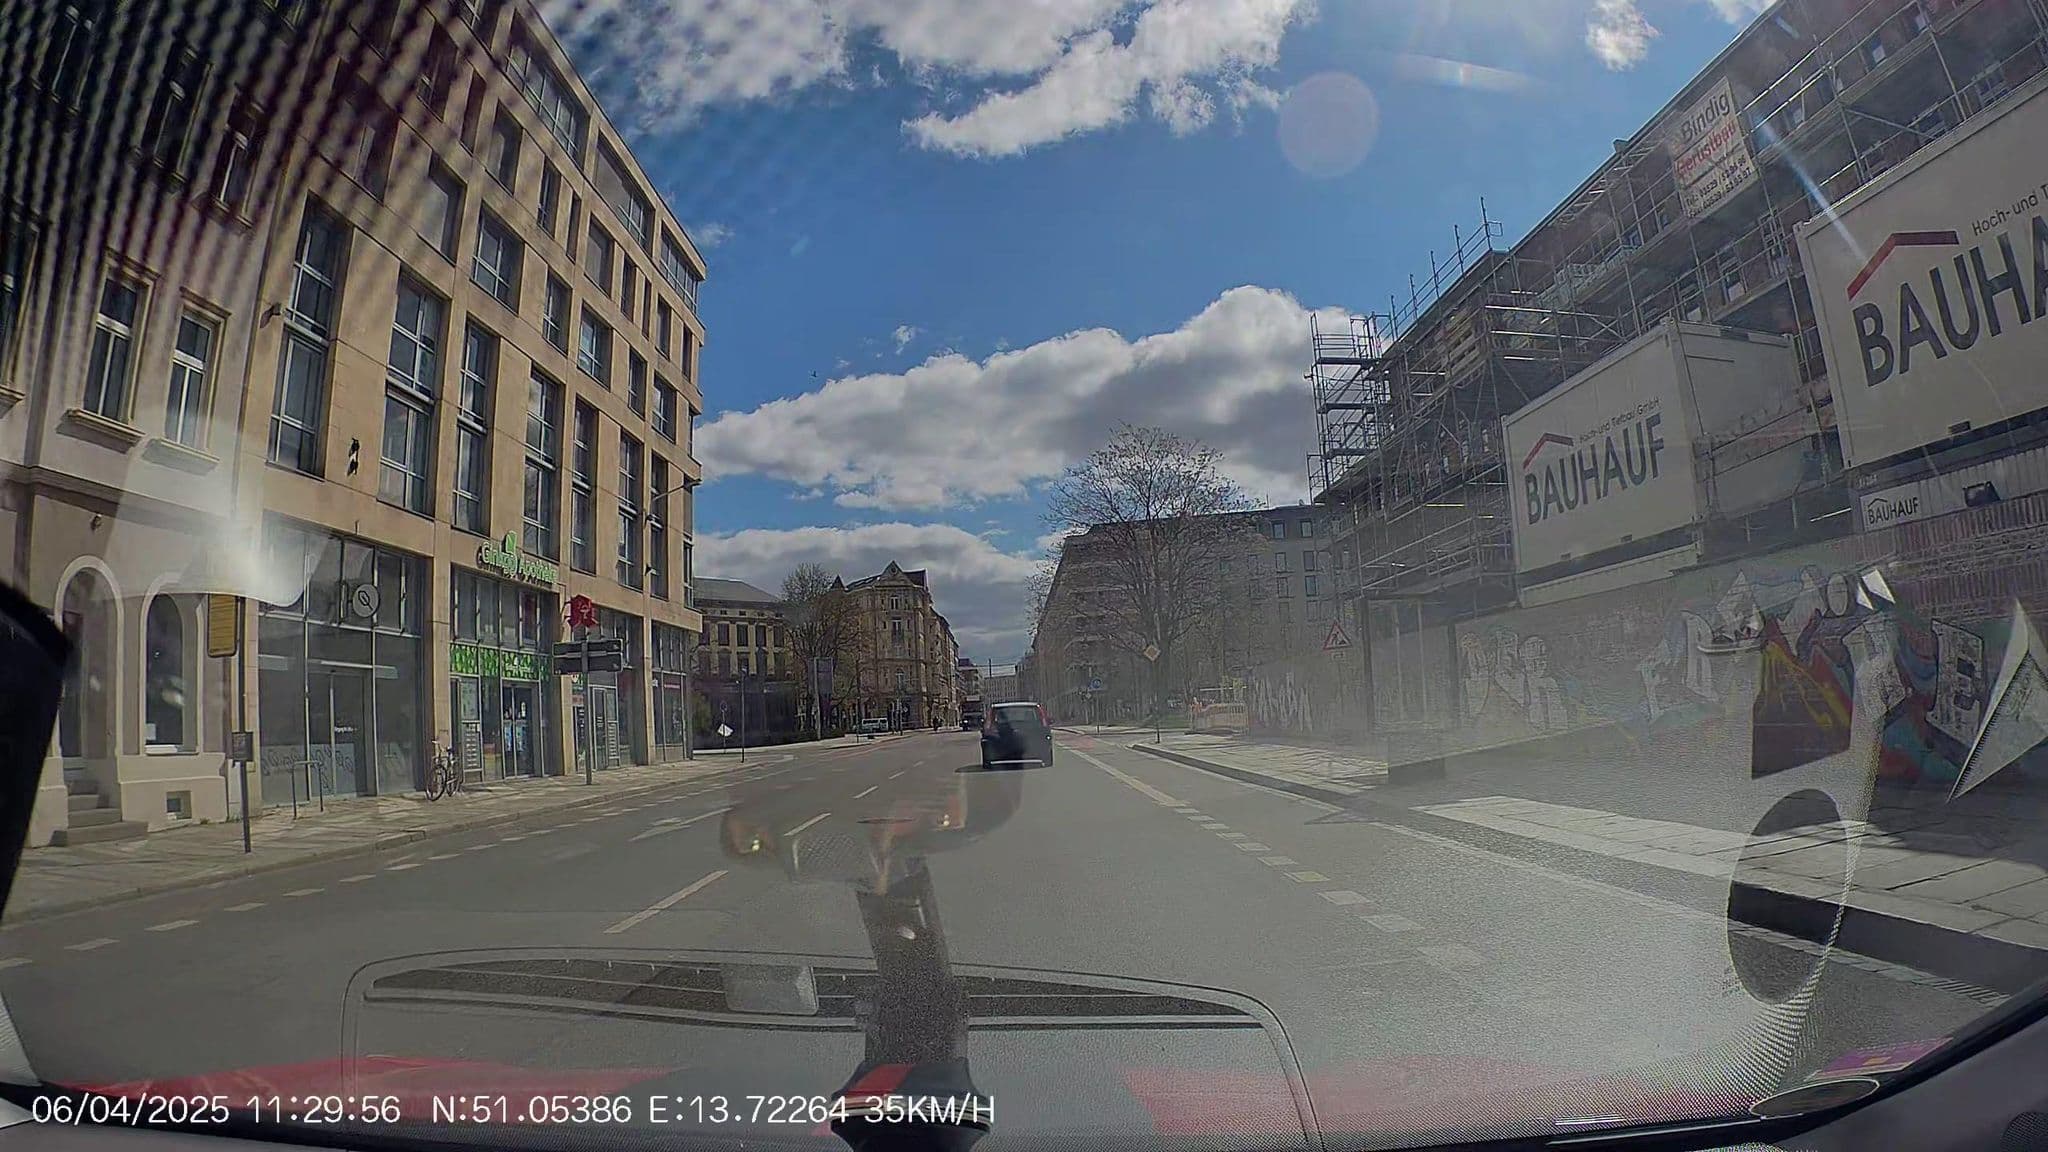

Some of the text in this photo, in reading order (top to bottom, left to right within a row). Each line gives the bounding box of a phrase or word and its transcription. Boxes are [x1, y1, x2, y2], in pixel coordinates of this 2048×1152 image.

[1680, 93, 1731, 143] Bindig
[1971, 207, 2011, 237] Hoch-
[2012, 194, 2040, 216] und
[1524, 413, 1664, 525] BAUHAUF
[1867, 496, 1920, 525] BAUHAUF
